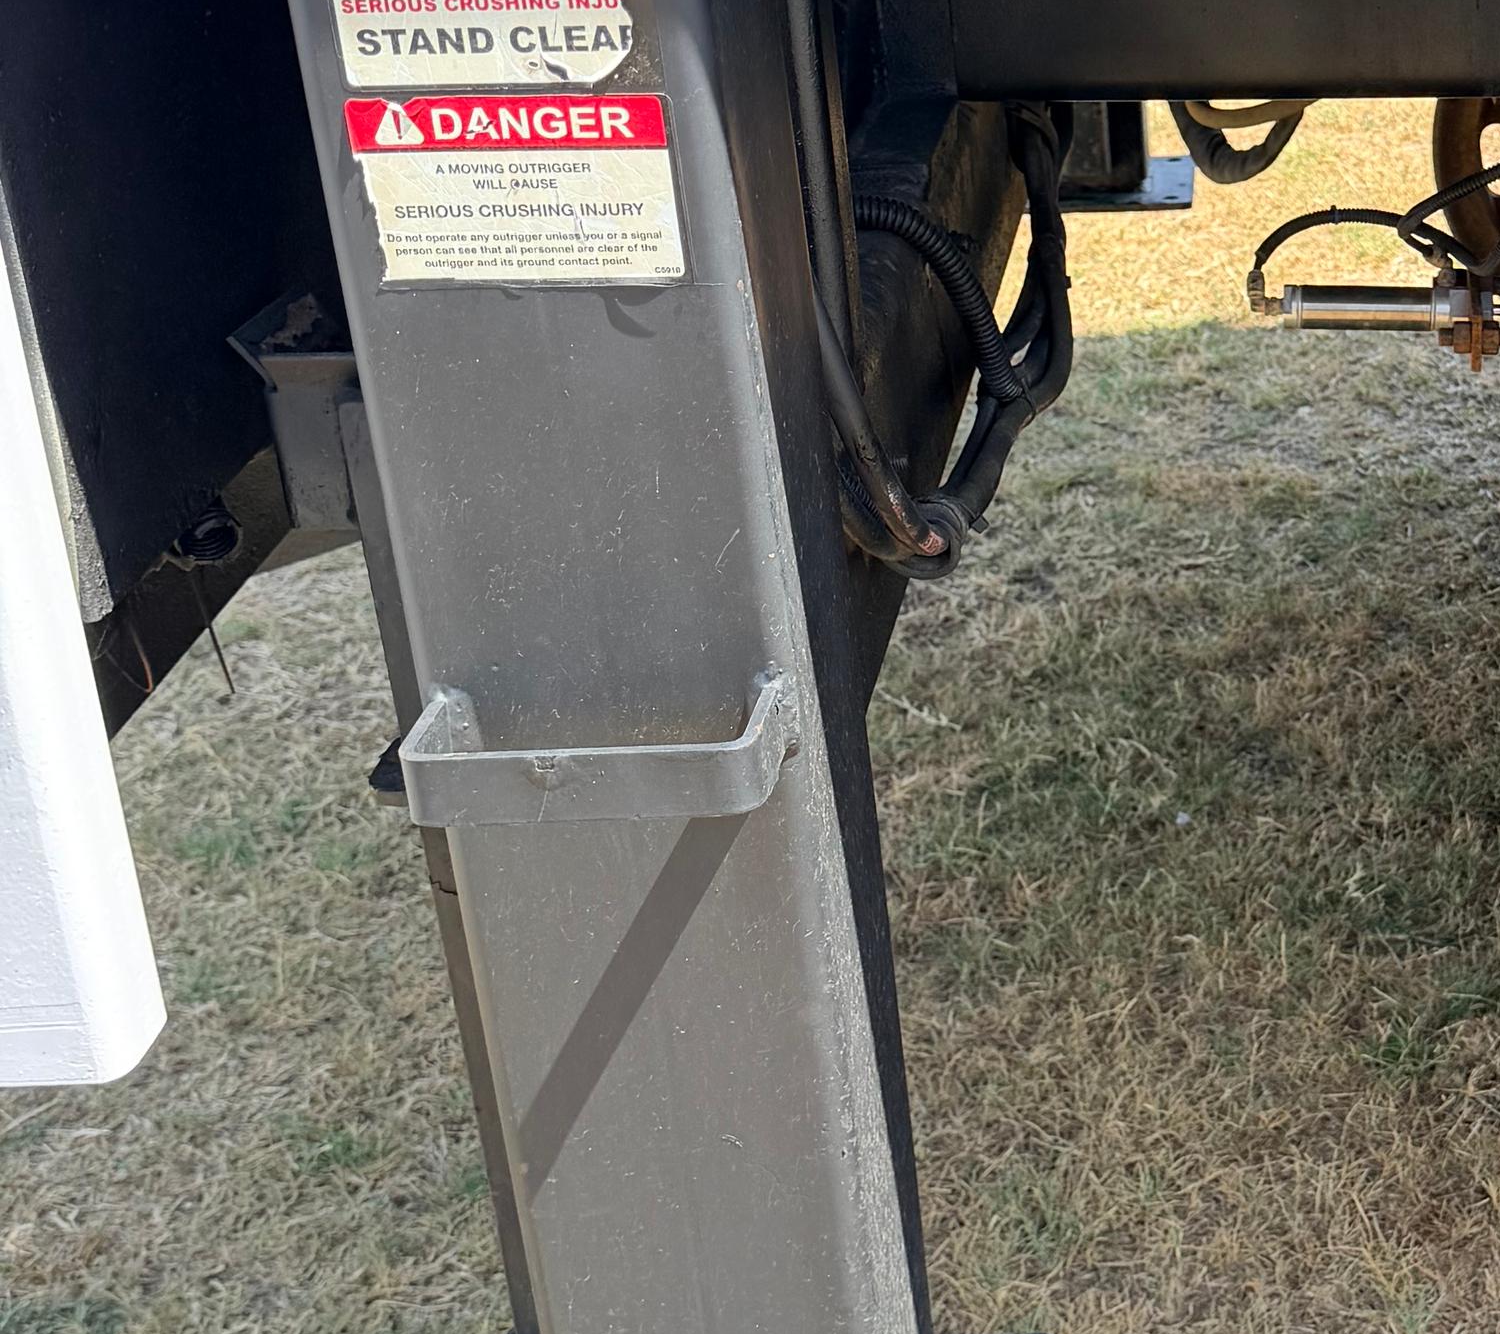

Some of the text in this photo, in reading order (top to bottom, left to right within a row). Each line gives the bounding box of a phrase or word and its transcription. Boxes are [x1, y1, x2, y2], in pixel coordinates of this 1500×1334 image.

[356, 26, 495, 56] STAND
[431, 106, 634, 140] DANGER
[435, 162, 591, 175] A MOVING OUTRIGGER
[472, 178, 507, 190] WILL
[395, 202, 644, 218] SERIOUS CRUSHING INJURY
[387, 230, 662, 246] Do not operate any outrigger unless you or a signal
[395, 243, 658, 256] person can see that all personnel are clear of the
[425, 257, 632, 269] outrigger and its ground contact point.
